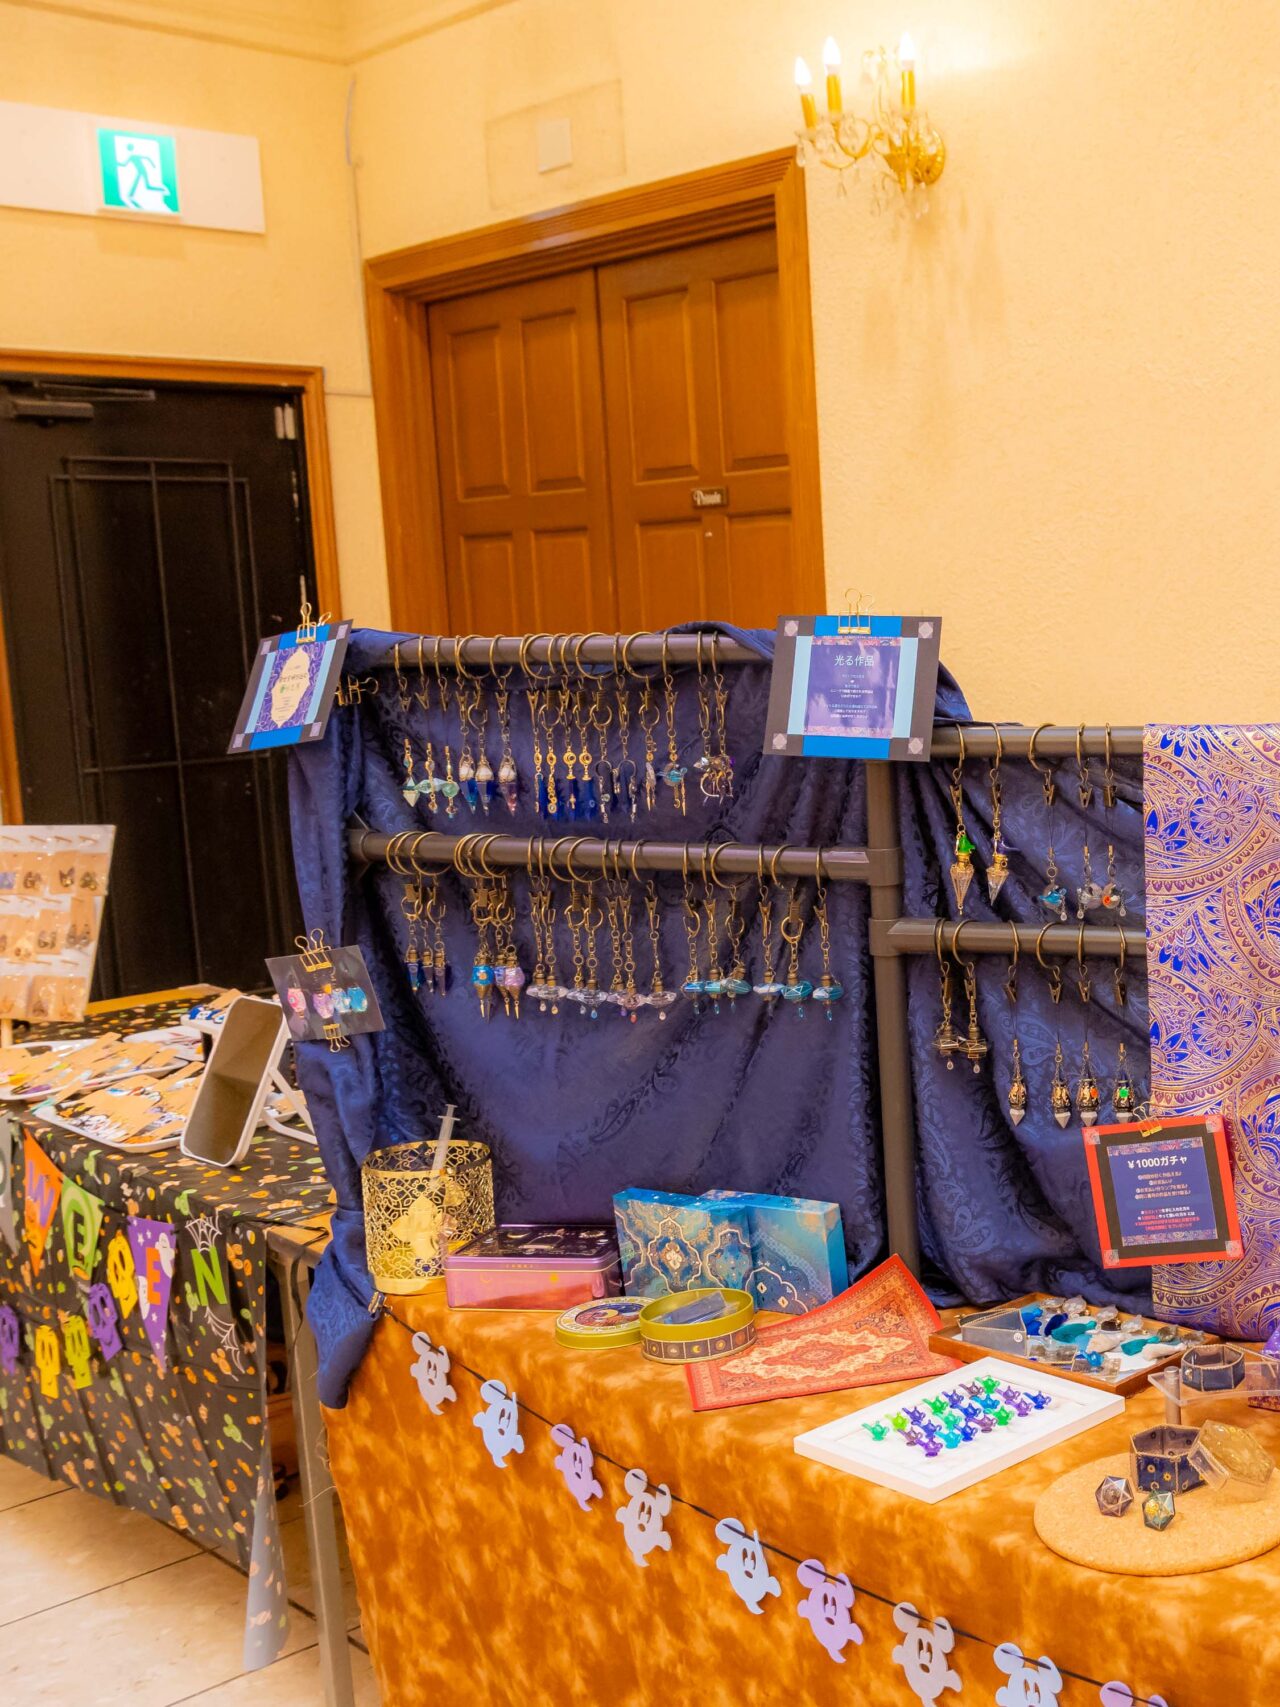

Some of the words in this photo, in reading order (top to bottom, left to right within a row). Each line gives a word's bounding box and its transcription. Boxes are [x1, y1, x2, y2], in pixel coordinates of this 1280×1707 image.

[834, 654, 875, 668] 光る作品
[1127, 1155, 1189, 1170] ¥1000ガチャ
